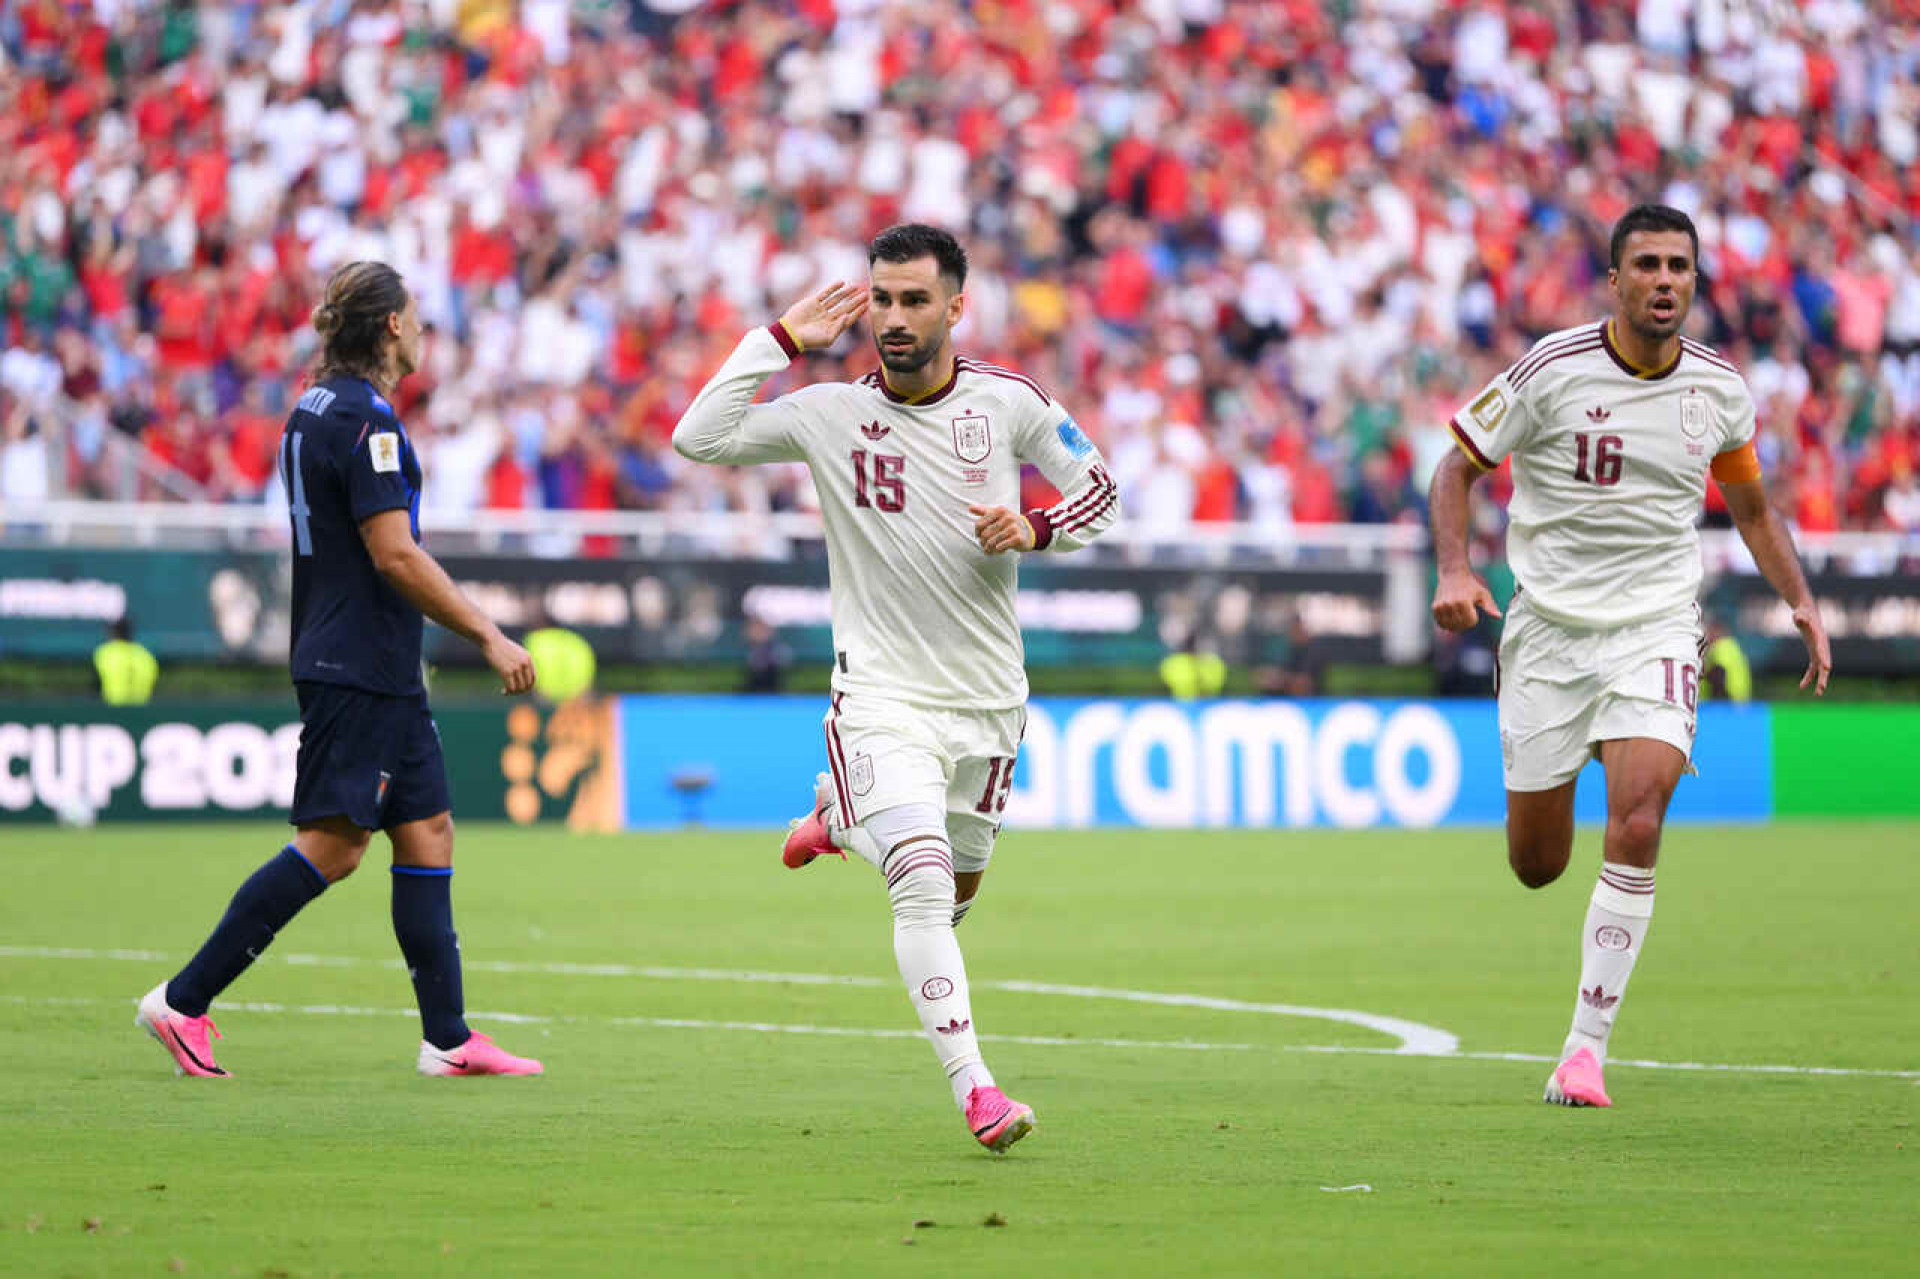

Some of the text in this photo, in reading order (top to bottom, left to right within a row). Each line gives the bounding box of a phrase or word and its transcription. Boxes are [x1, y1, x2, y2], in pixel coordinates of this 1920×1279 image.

[851, 449, 905, 513] 15
[1574, 433, 1623, 486] 16
[1661, 658, 1697, 712] 16
[0, 722, 136, 811] CUP
[1005, 700, 1462, 828] aramco
